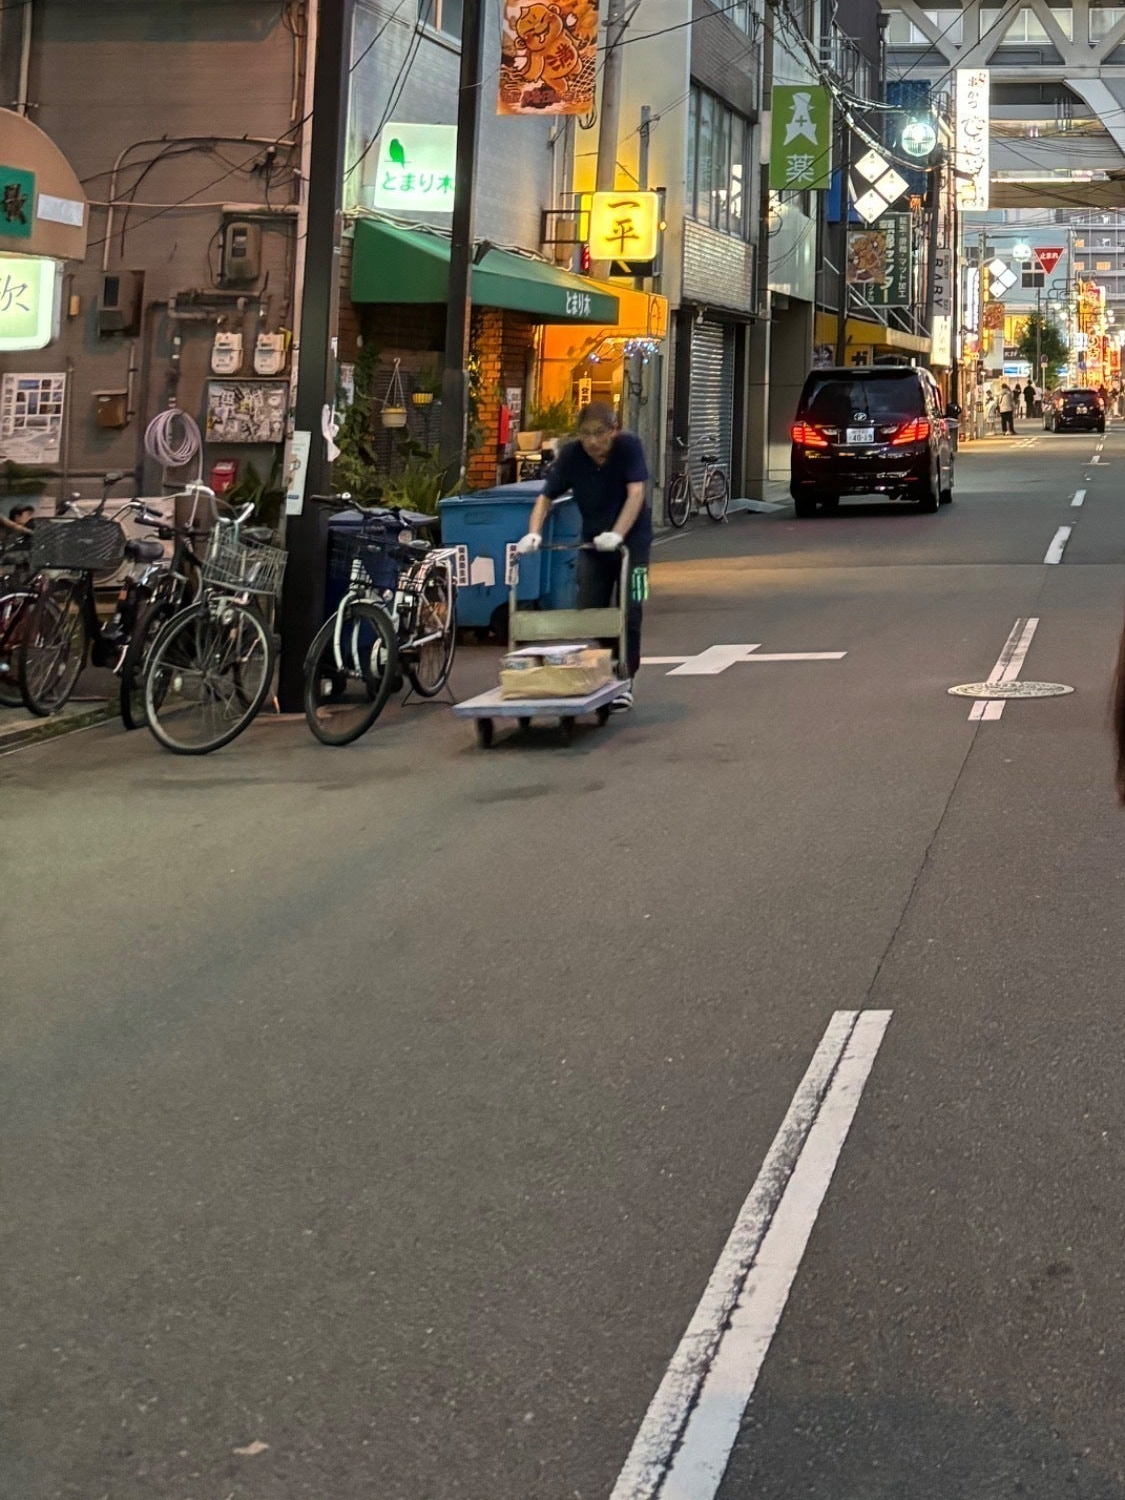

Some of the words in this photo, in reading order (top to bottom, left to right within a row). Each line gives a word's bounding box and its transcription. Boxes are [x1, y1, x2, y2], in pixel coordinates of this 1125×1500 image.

[785, 153, 816, 183] 薬
[382, 171, 454, 194] とまり木
[605, 201, 640, 254] 一平
[565, 291, 592, 316] とまり木
